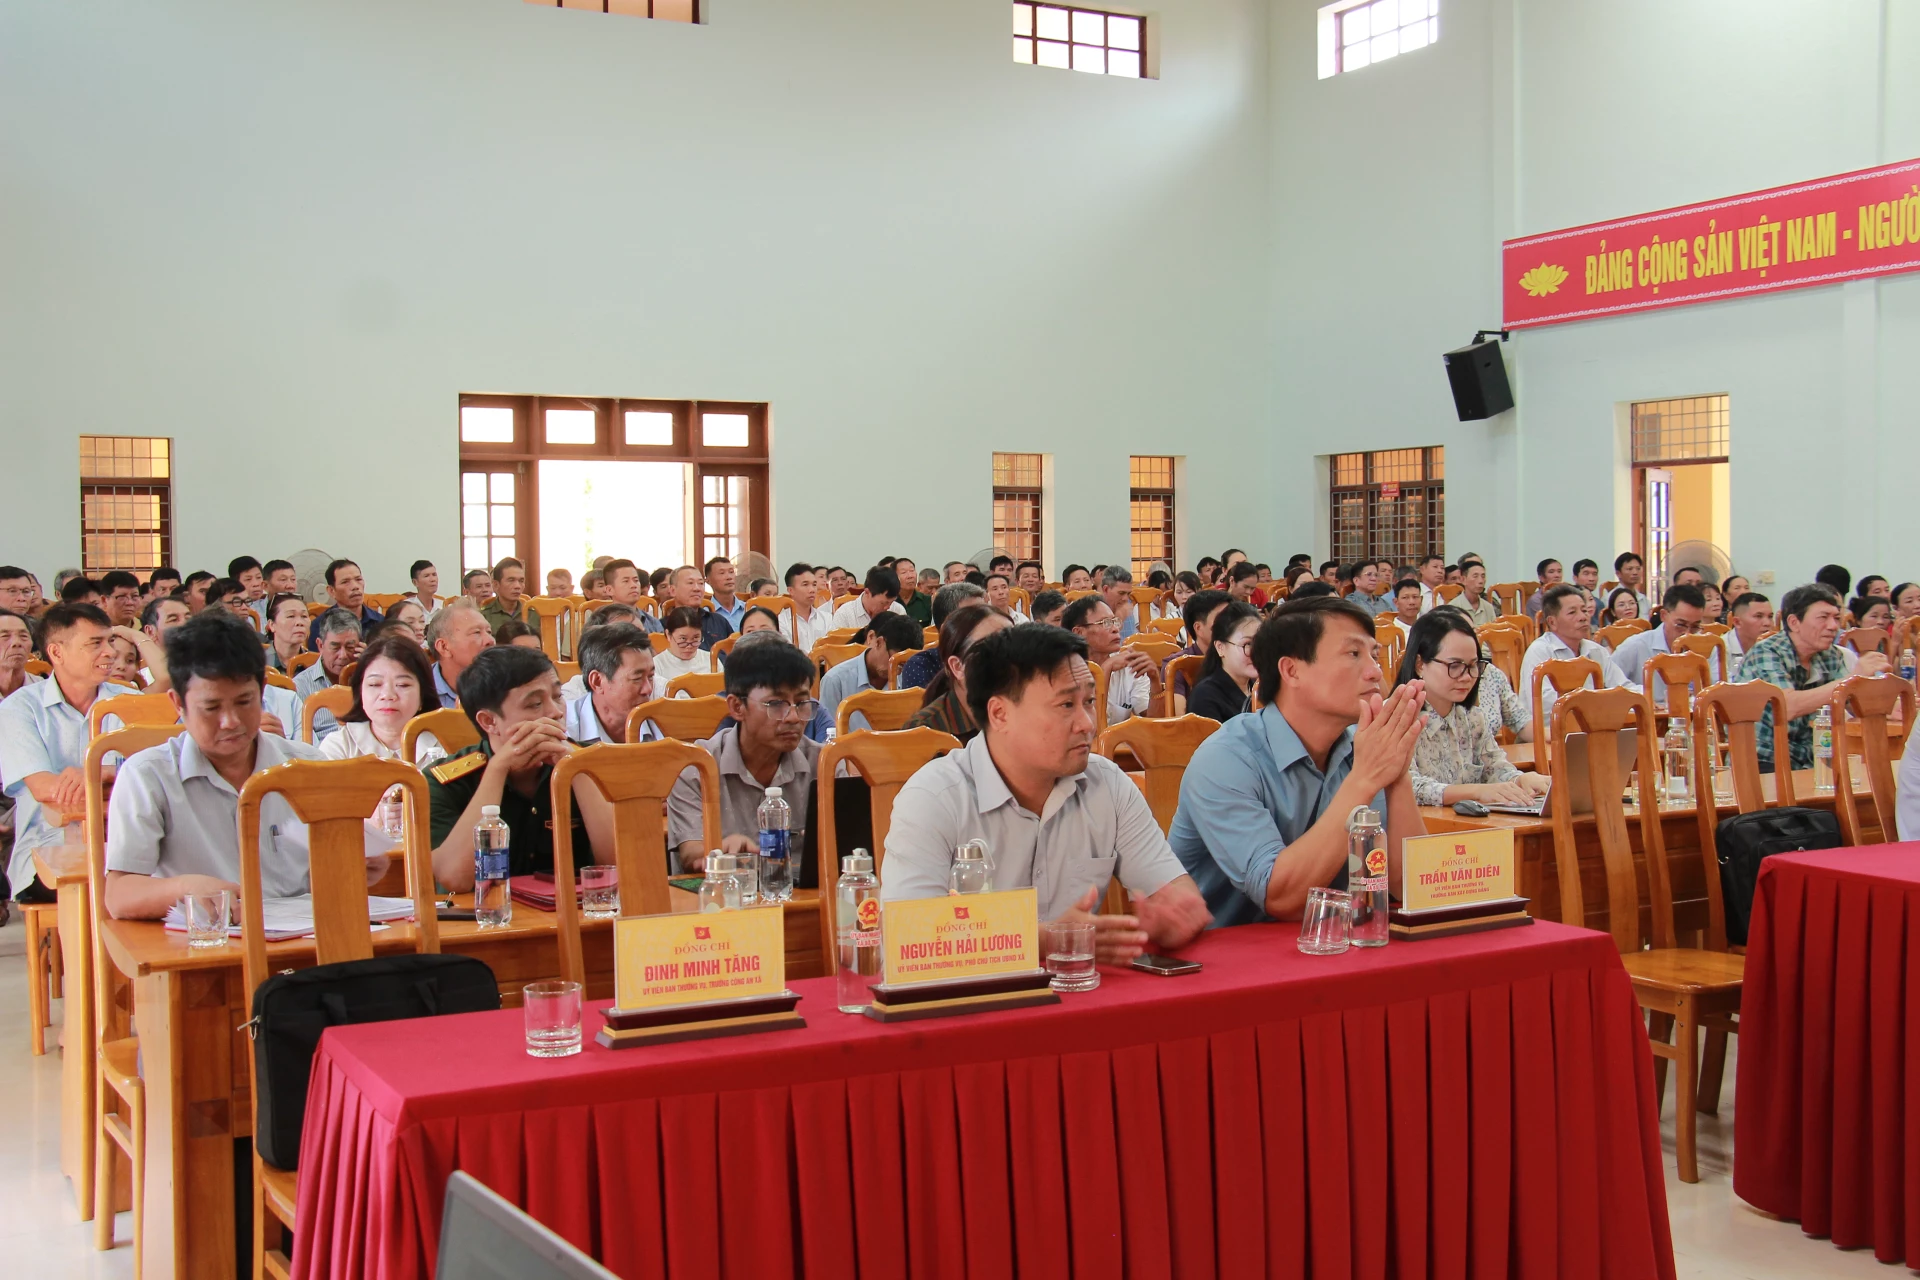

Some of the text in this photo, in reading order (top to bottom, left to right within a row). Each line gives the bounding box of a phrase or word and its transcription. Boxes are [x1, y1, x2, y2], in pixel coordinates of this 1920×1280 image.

[1585, 239, 1633, 295] ĐẢNG
[1638, 234, 1688, 294] CỘNG
[1693, 219, 1733, 279] SẢN
[1738, 215, 1781, 278] VIỆT
[1786, 211, 1836, 264] NAM
[1451, 868, 1472, 881] VĂN
[900, 933, 1022, 960] NGUYỄN HẢI LƯƠNG
[644, 953, 760, 982] ĐINH MINH TĂNG
